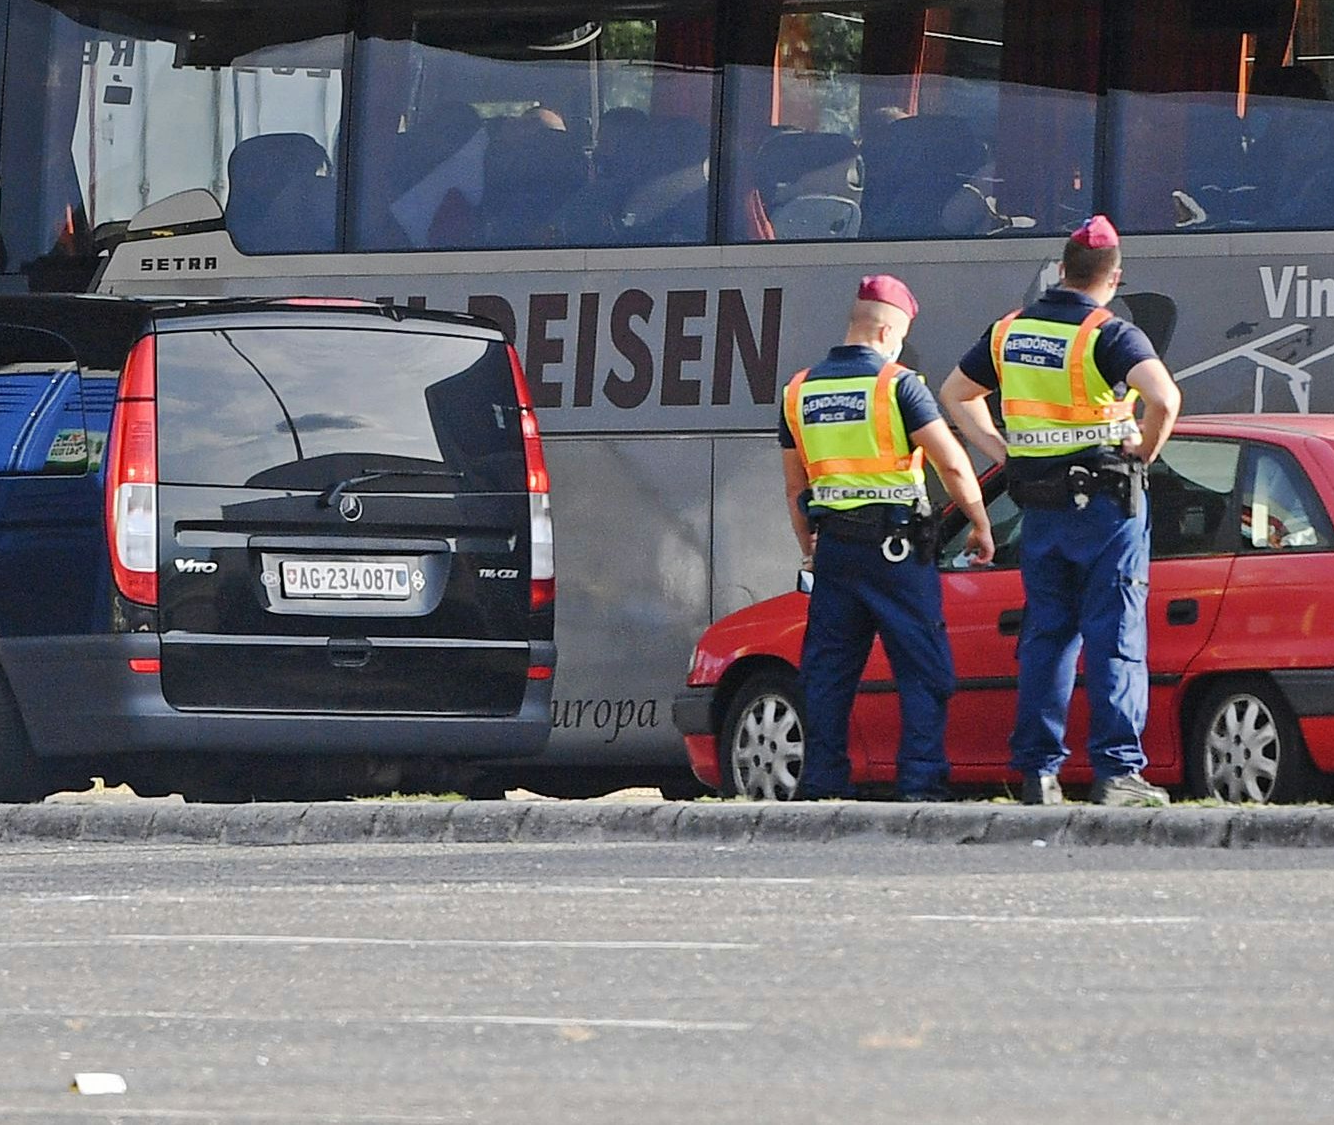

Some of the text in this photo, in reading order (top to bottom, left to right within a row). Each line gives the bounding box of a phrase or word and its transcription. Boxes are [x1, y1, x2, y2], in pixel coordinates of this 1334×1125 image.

[141, 257, 217, 271] SETRA
[1017, 431, 1070, 444] POLICE
[551, 699, 659, 744] uropa
